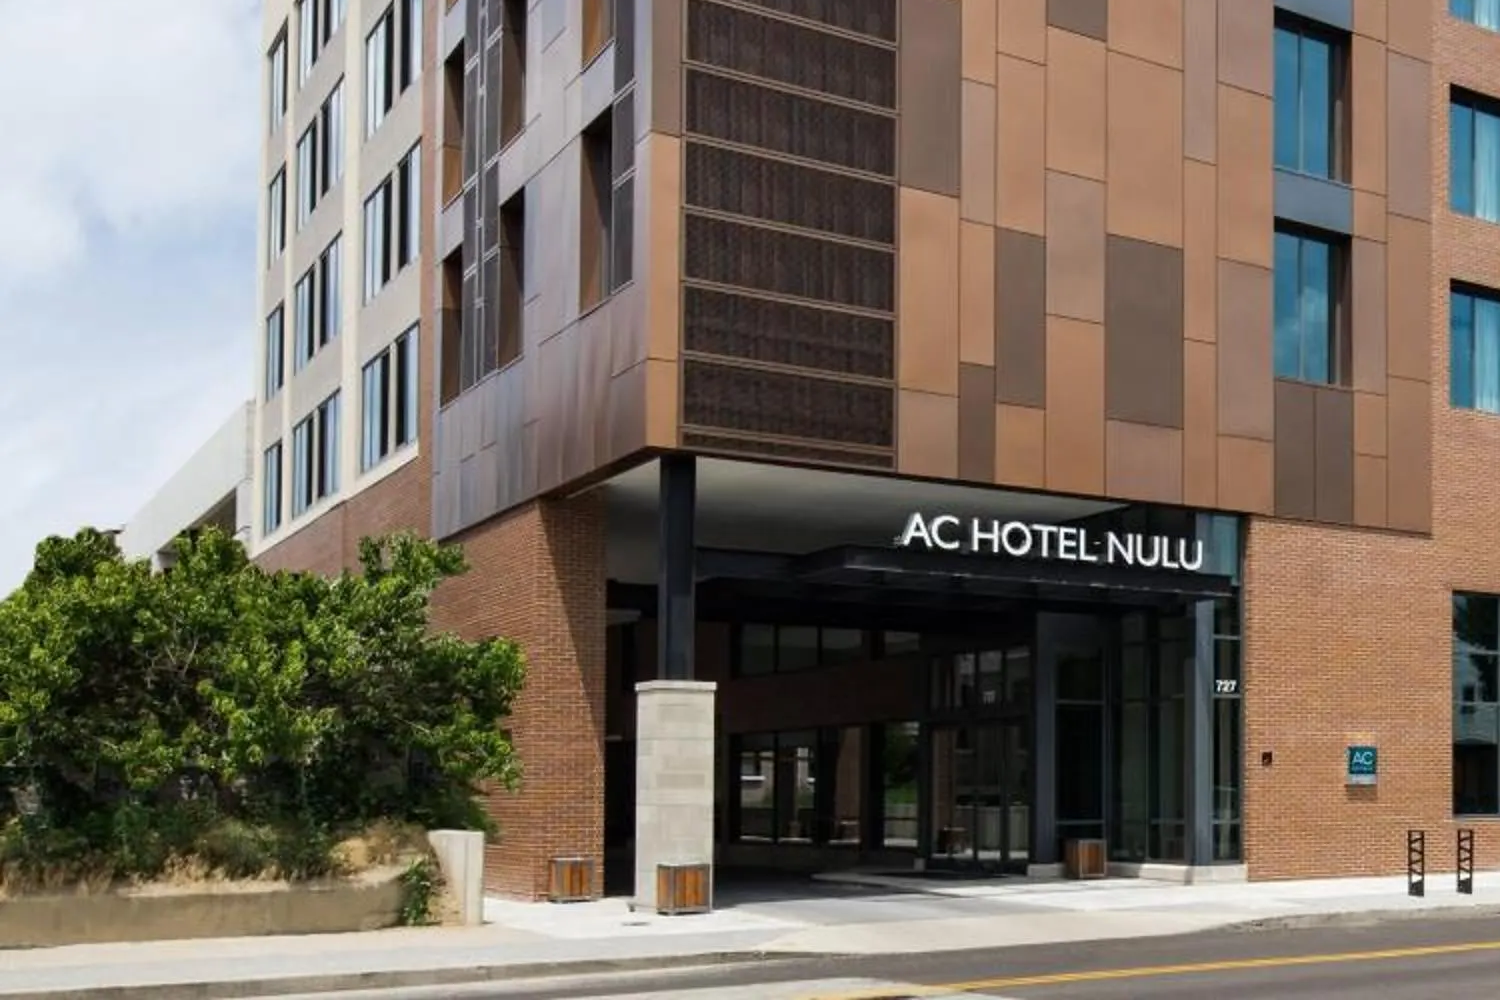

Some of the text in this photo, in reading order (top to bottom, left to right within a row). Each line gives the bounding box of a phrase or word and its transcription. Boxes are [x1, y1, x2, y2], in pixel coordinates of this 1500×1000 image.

[903, 512, 1204, 570] AC HOTEL NULU
[1215, 679, 1237, 693] 727
[1352, 751, 1374, 765] AC
